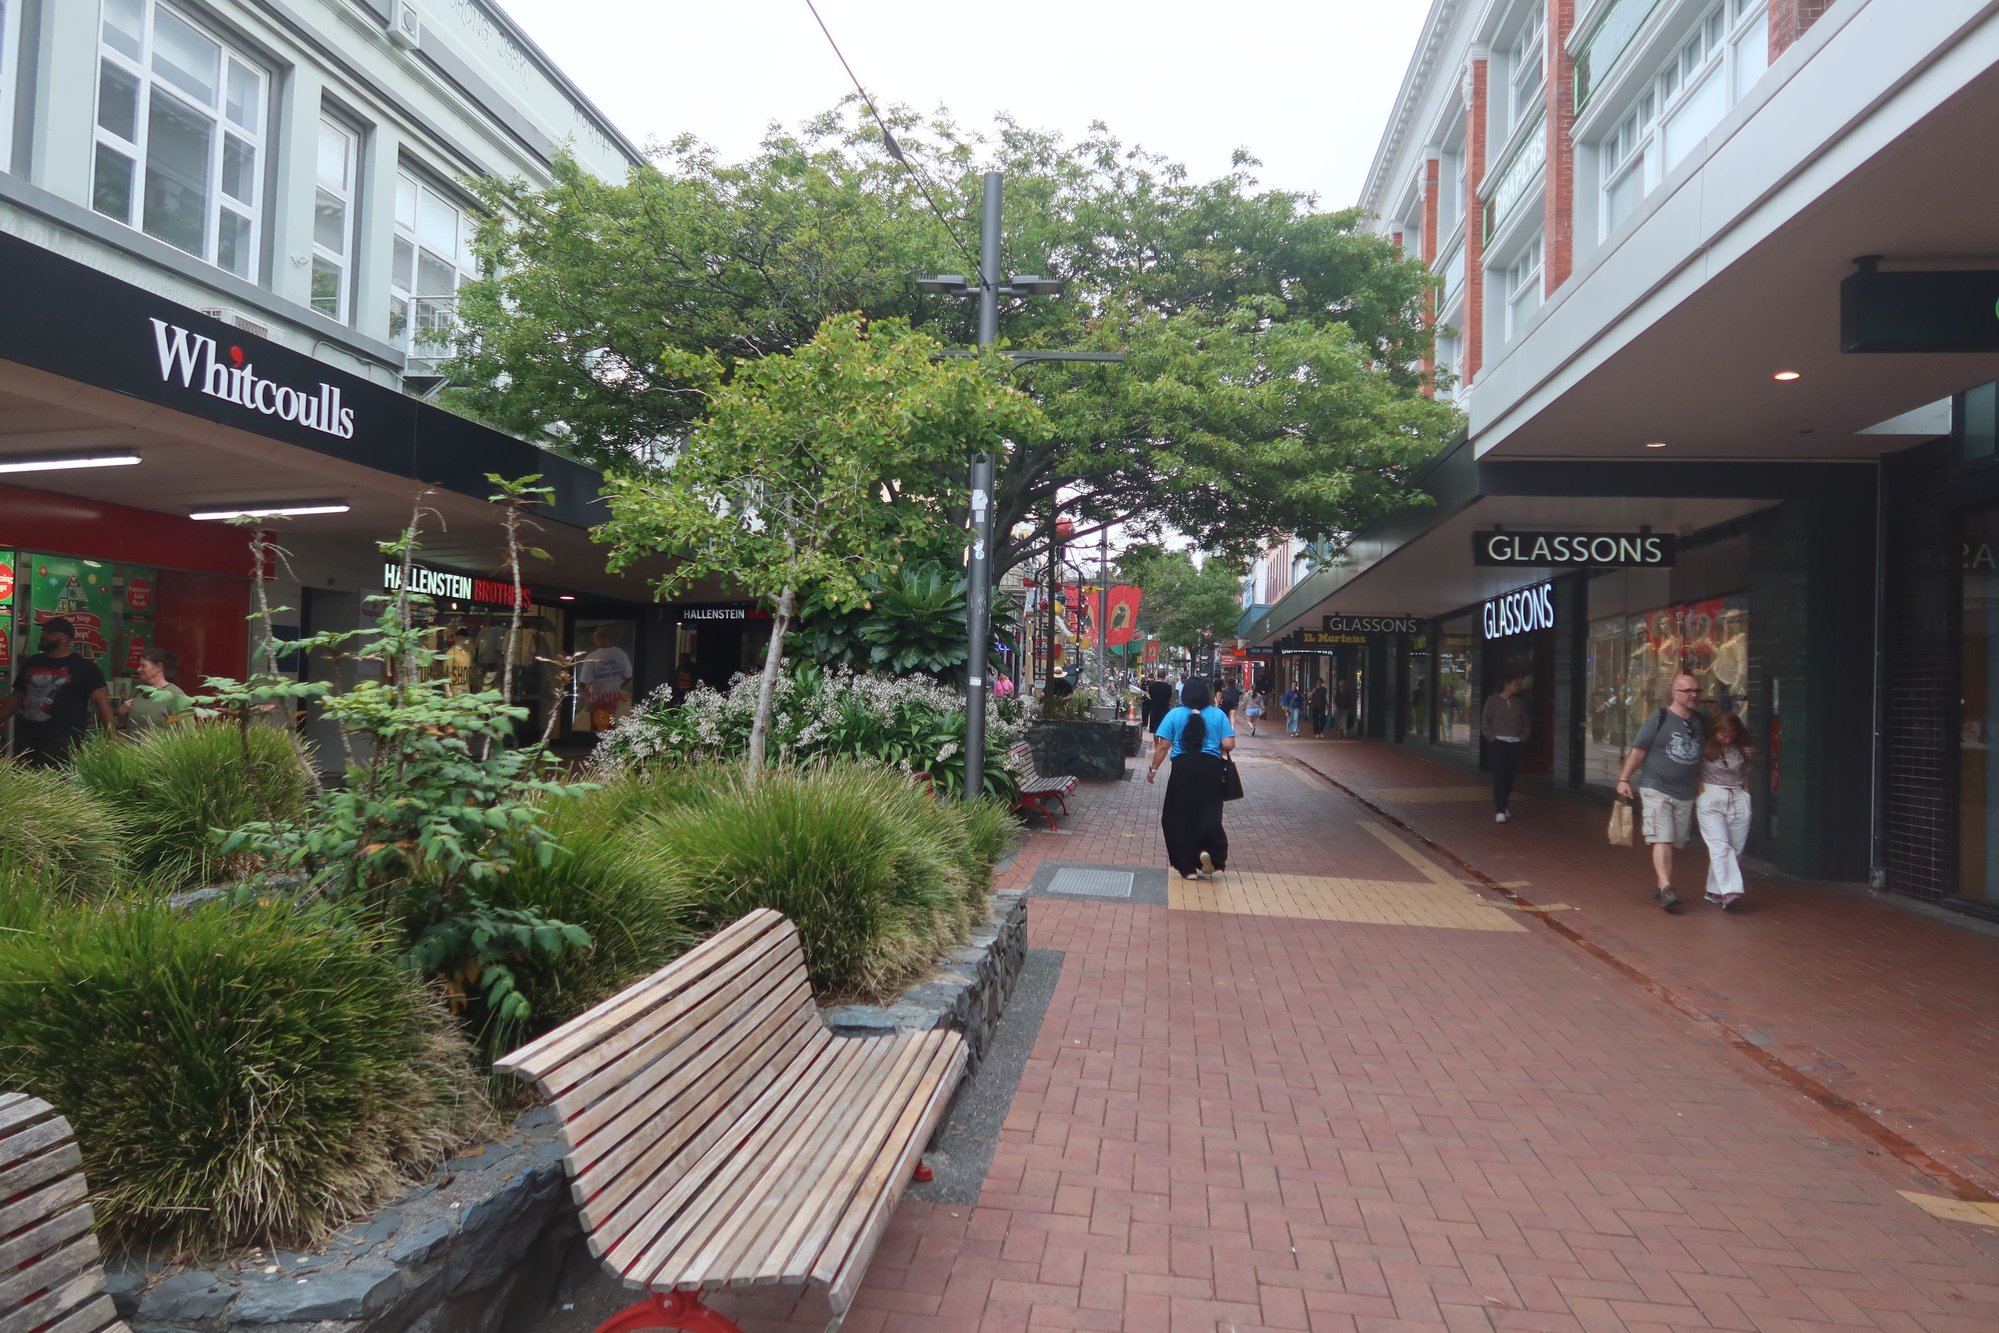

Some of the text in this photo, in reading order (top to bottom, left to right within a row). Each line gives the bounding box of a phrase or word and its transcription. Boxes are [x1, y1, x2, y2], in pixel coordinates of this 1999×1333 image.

[1495, 129, 1545, 223] DRAPERS
[149, 316, 355, 440] Whitcoulls
[1488, 535, 1662, 563] GLASSONS
[475, 578, 532, 609] BROTHS
[683, 609, 745, 619] HALLENSTEIN
[1330, 617, 1417, 633] GLASSONS
[1483, 583, 1554, 639] GLASSONS
[74, 629, 91, 641] hop!
[1318, 632, 1367, 644] Martens
